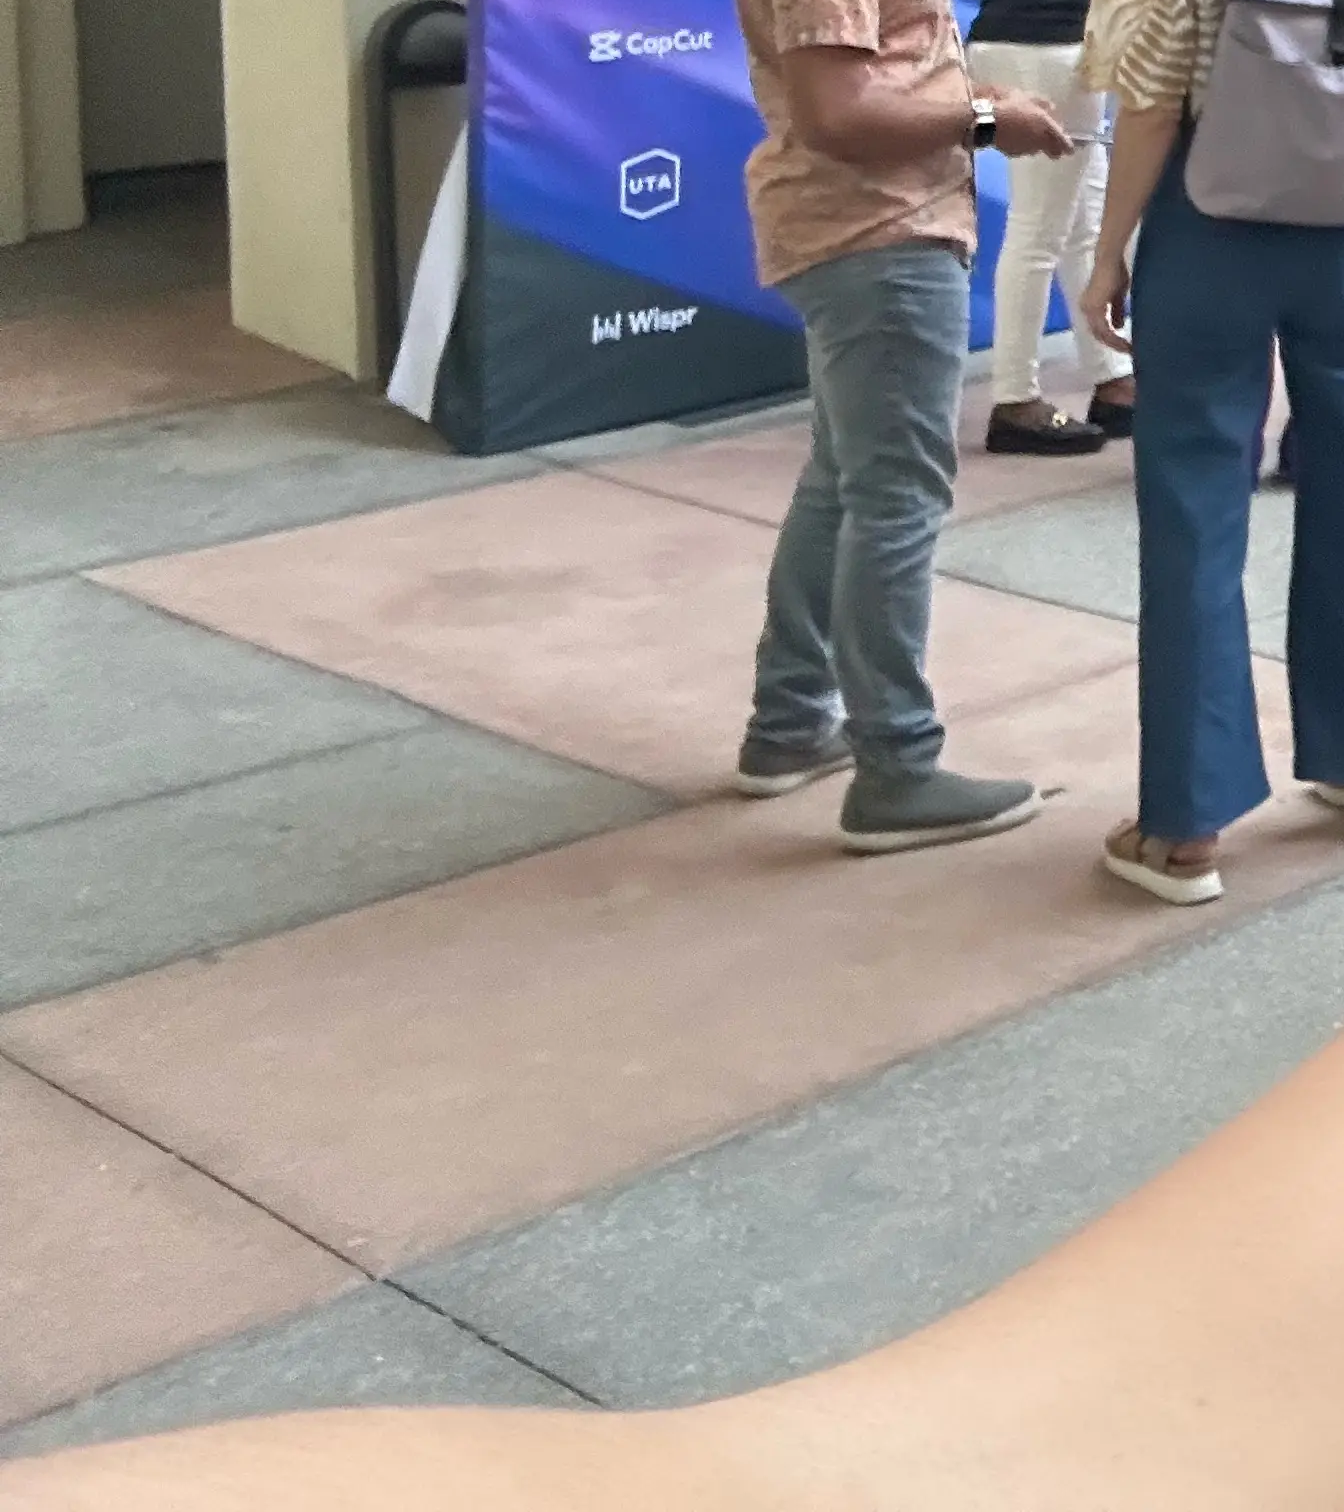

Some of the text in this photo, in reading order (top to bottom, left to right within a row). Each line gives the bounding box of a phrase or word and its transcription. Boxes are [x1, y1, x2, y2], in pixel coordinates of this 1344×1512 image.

[625, 28, 713, 57] CapCut
[628, 173, 672, 195] UTA
[628, 306, 698, 335] Wispr
